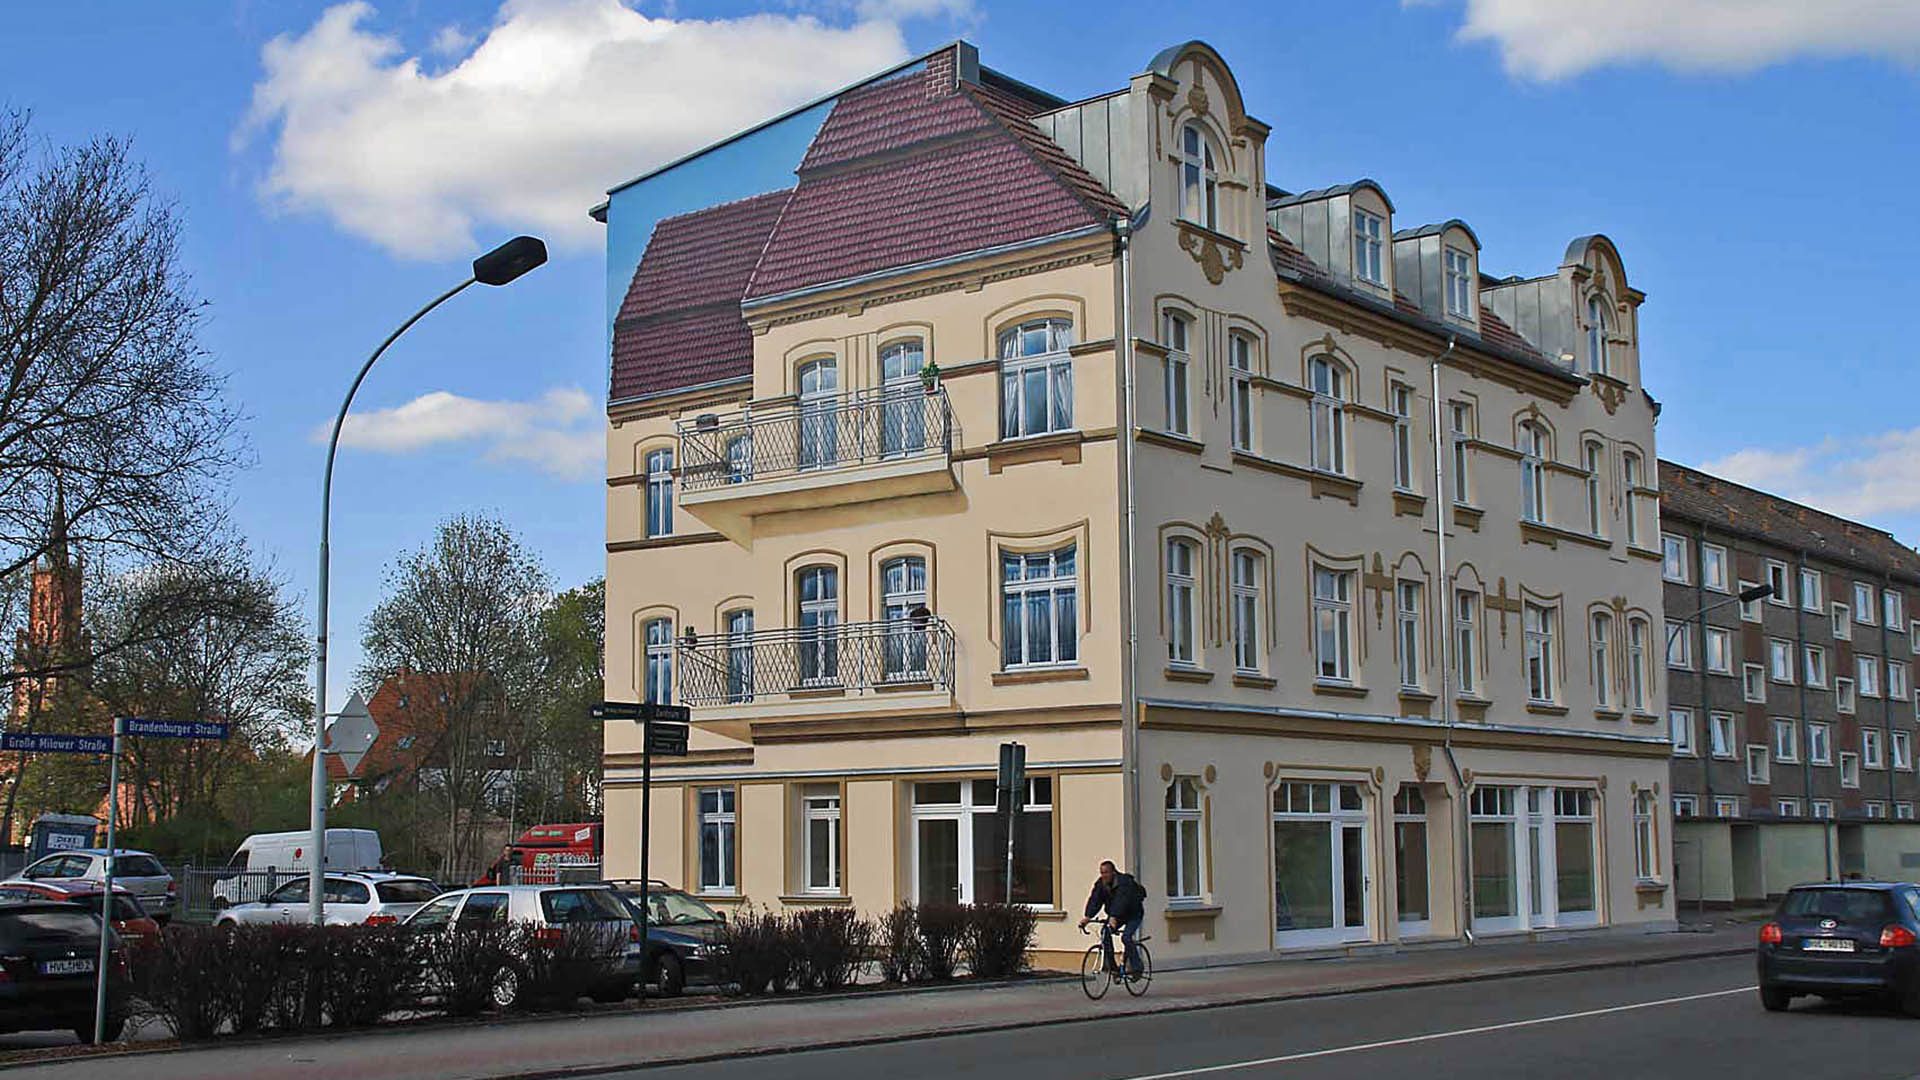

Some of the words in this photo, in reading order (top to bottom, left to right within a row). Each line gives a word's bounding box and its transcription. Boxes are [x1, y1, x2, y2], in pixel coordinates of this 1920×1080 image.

[129, 721, 191, 736] Brandenburger
[195, 724, 222, 735] Straße
[9, 737, 35, 748] Große
[39, 738, 74, 750] Milower
[79, 739, 107, 751] Straße
